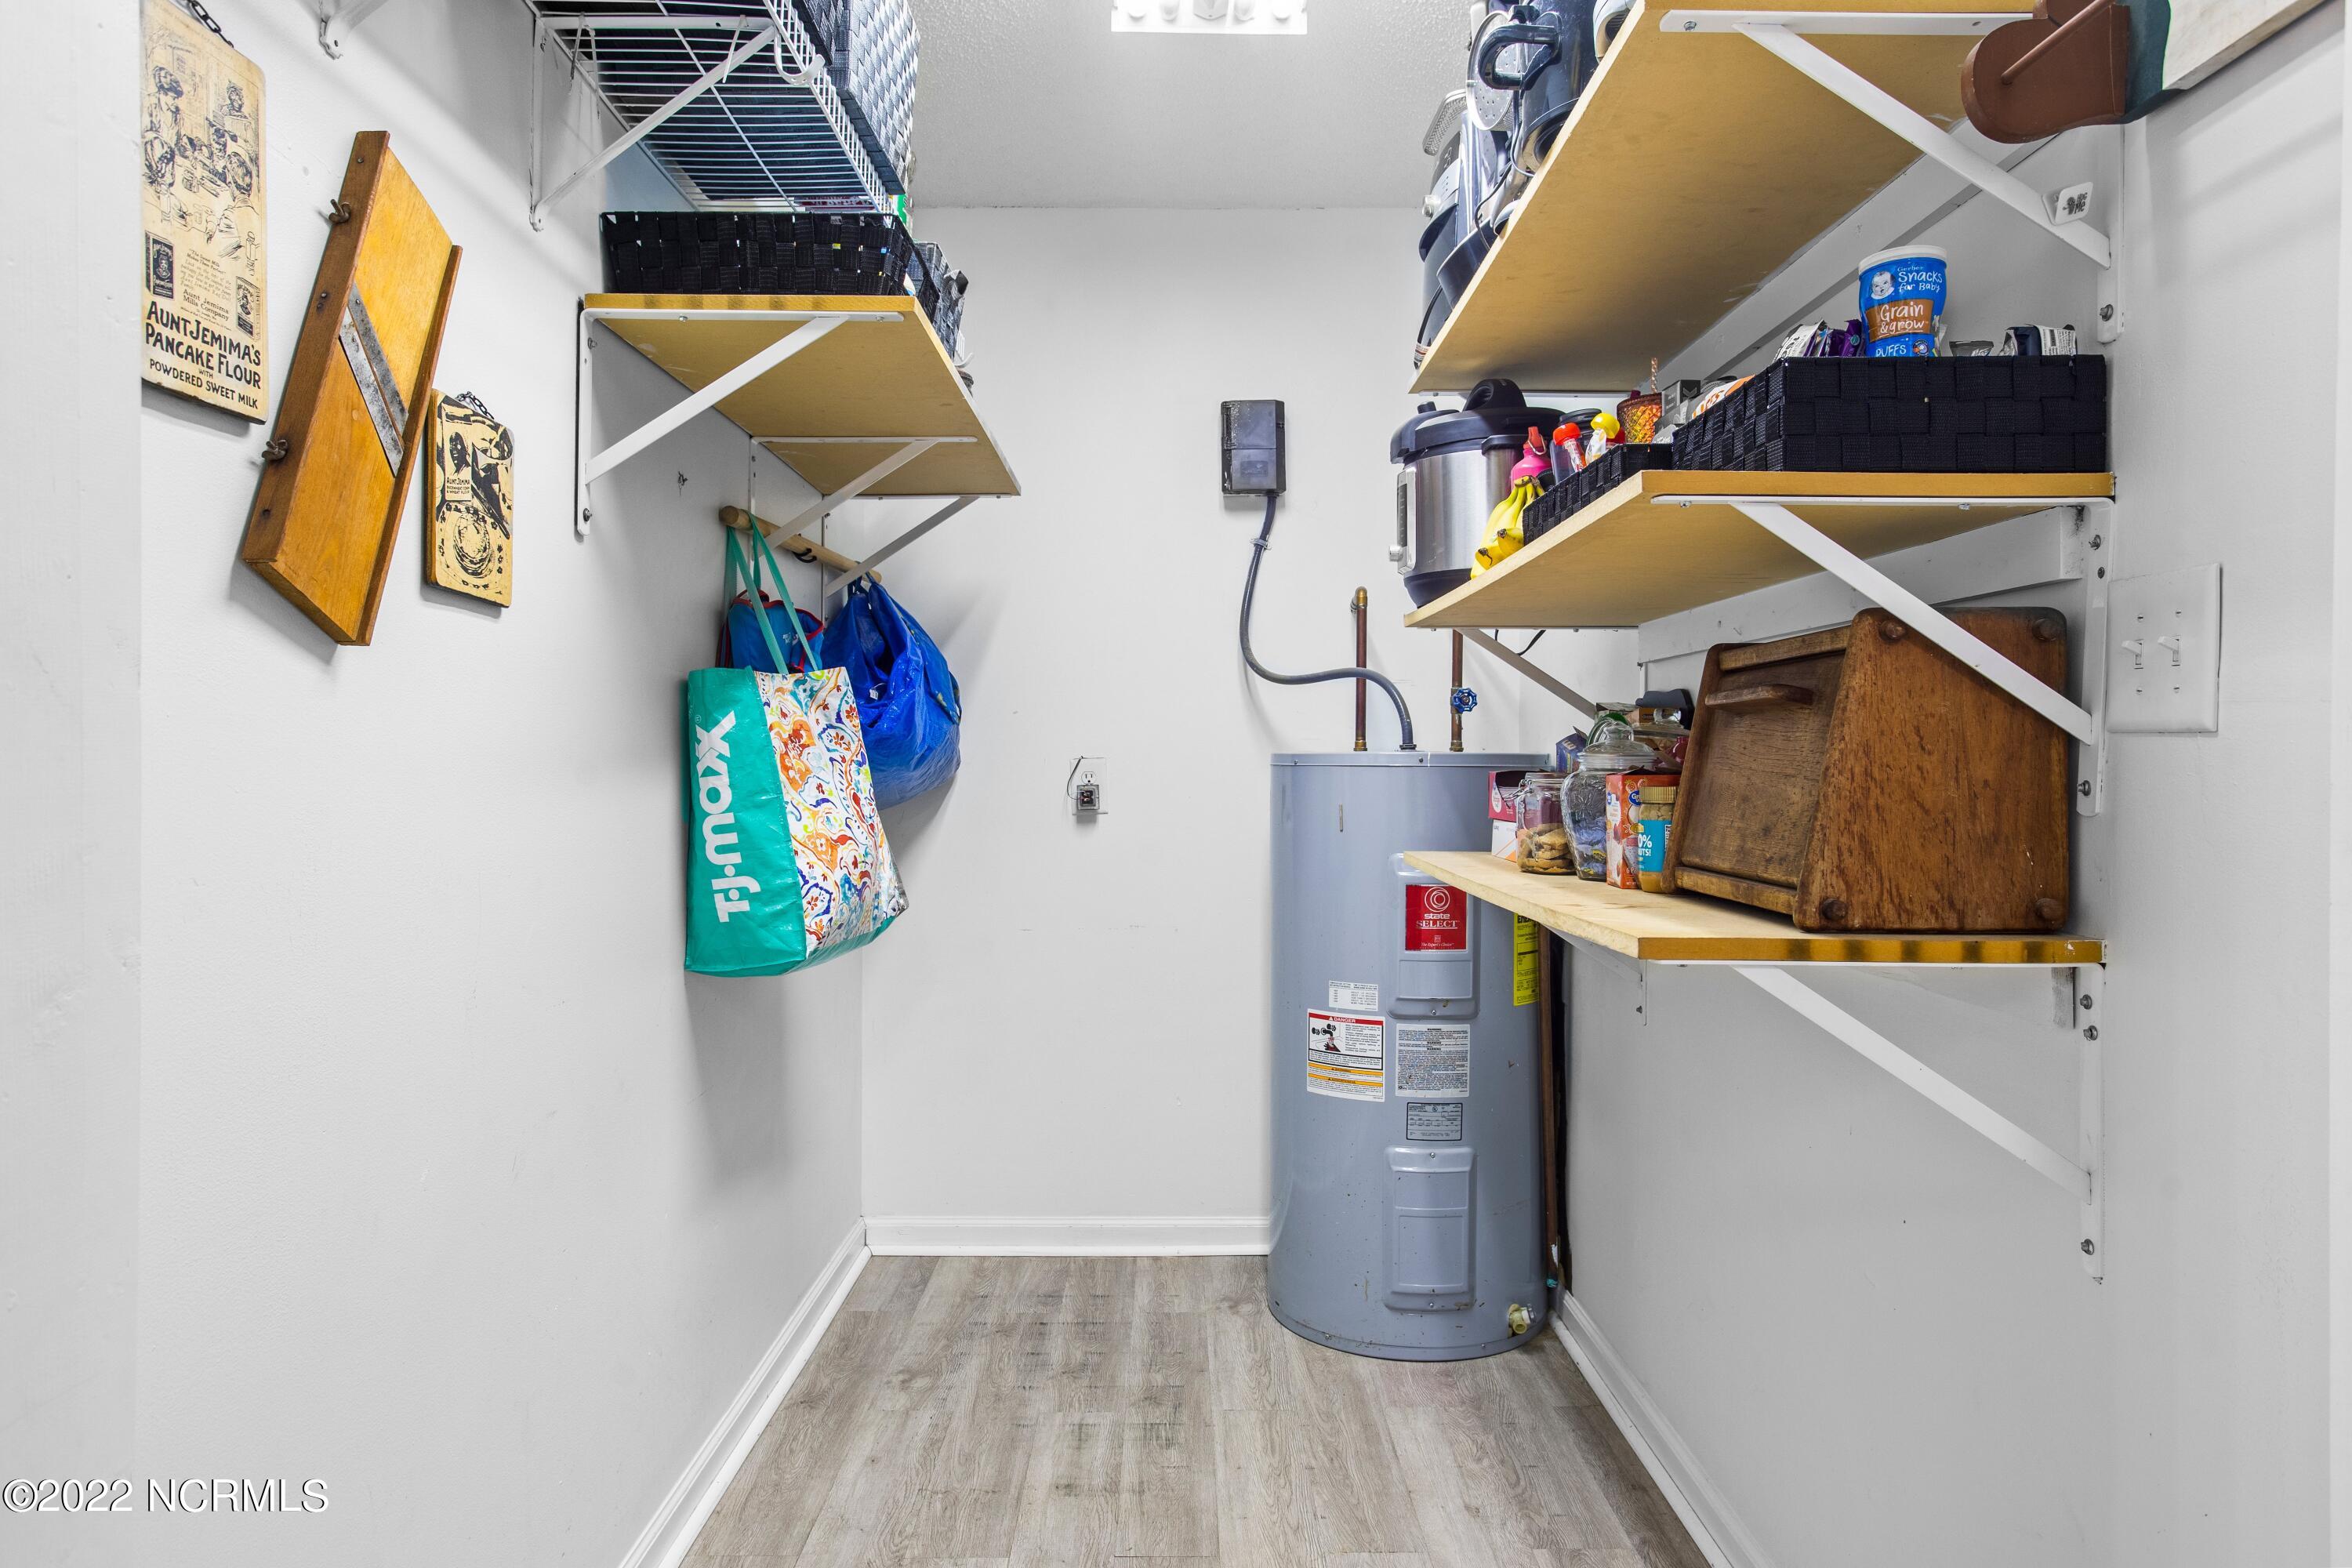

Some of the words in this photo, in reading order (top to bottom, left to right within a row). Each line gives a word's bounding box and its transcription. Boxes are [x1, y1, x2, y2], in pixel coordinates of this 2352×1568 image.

[1898, 271, 1943, 283] Snacks
[1899, 283, 1915, 292] for
[1919, 282, 1940, 293] Baby
[183, 289, 201, 301] Aunt
[203, 298, 229, 314] Jemima
[183, 295, 198, 307] Mills
[201, 303, 229, 321] Company
[1880, 301, 1924, 322] Grain
[147, 300, 191, 336] AUNT
[189, 320, 261, 367] JEMIMA'S
[146, 322, 214, 371] PANCAKE
[218, 352, 261, 390] FLOUR
[1876, 344, 1907, 357] PUFFS
[150, 358, 203, 388] POWDERED
[205, 380, 235, 401] SWEET
[238, 392, 258, 409] MILK
[199, 368, 213, 379] WITH
